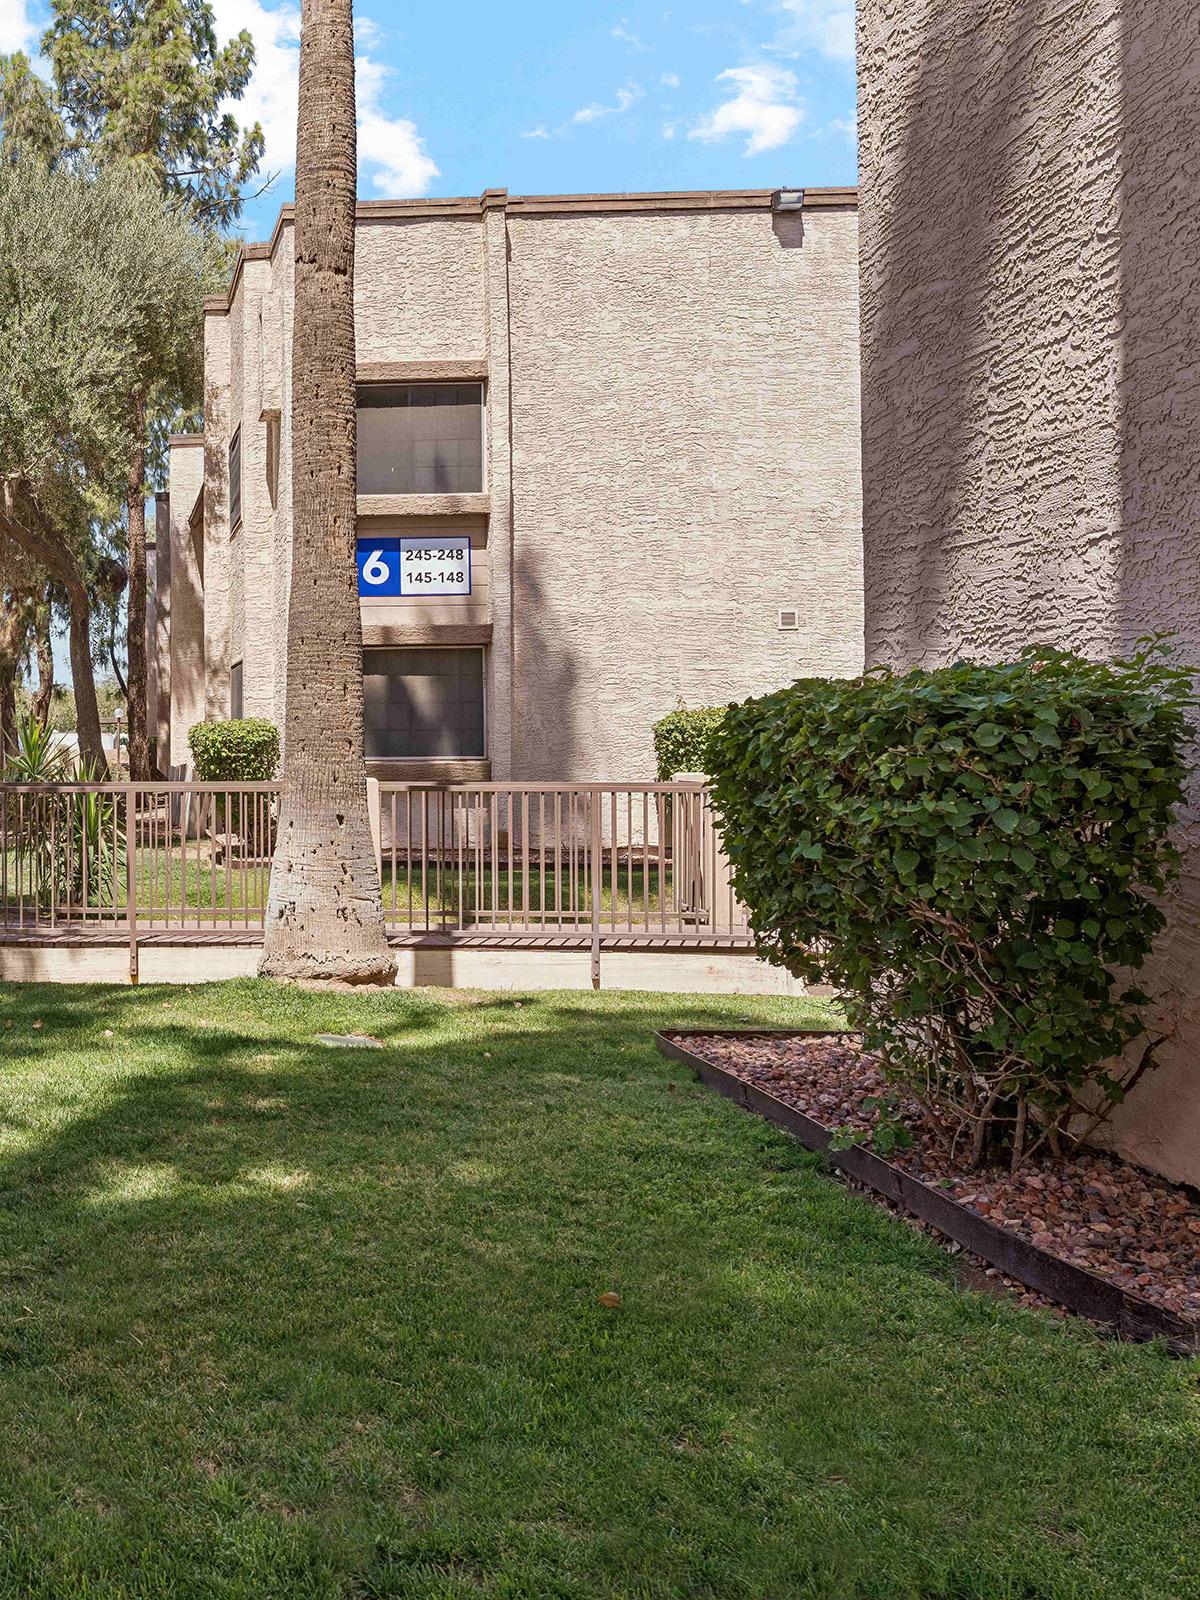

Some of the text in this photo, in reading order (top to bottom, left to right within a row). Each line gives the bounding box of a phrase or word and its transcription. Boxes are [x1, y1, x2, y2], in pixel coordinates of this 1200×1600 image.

[405, 549, 464, 561] 245-248
[363, 549, 390, 585] 6
[406, 571, 464, 583] 145-148
